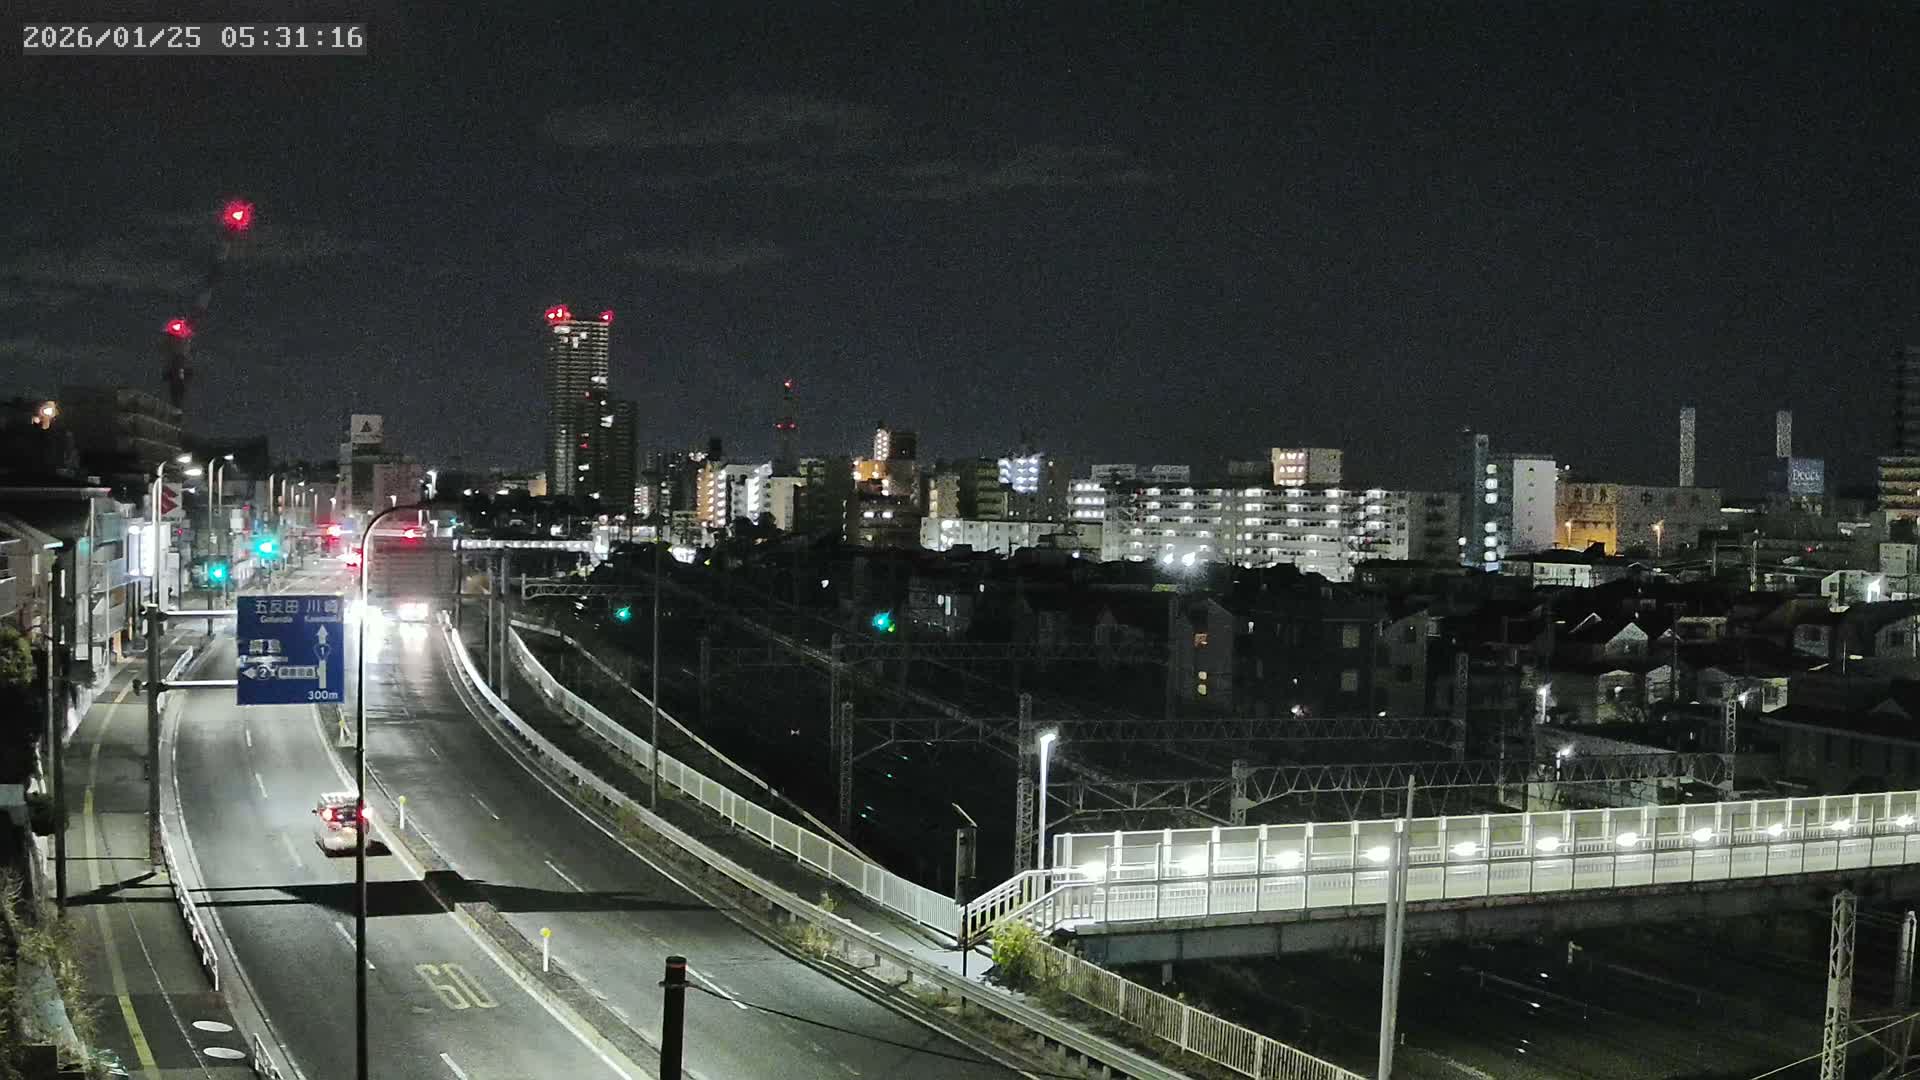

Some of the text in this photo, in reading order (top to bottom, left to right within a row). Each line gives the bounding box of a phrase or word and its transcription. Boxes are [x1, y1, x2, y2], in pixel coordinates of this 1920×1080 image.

[255, 600, 298, 614] 五反田
[307, 690, 338, 701] 300m
[414, 964, 499, 1010] 60
